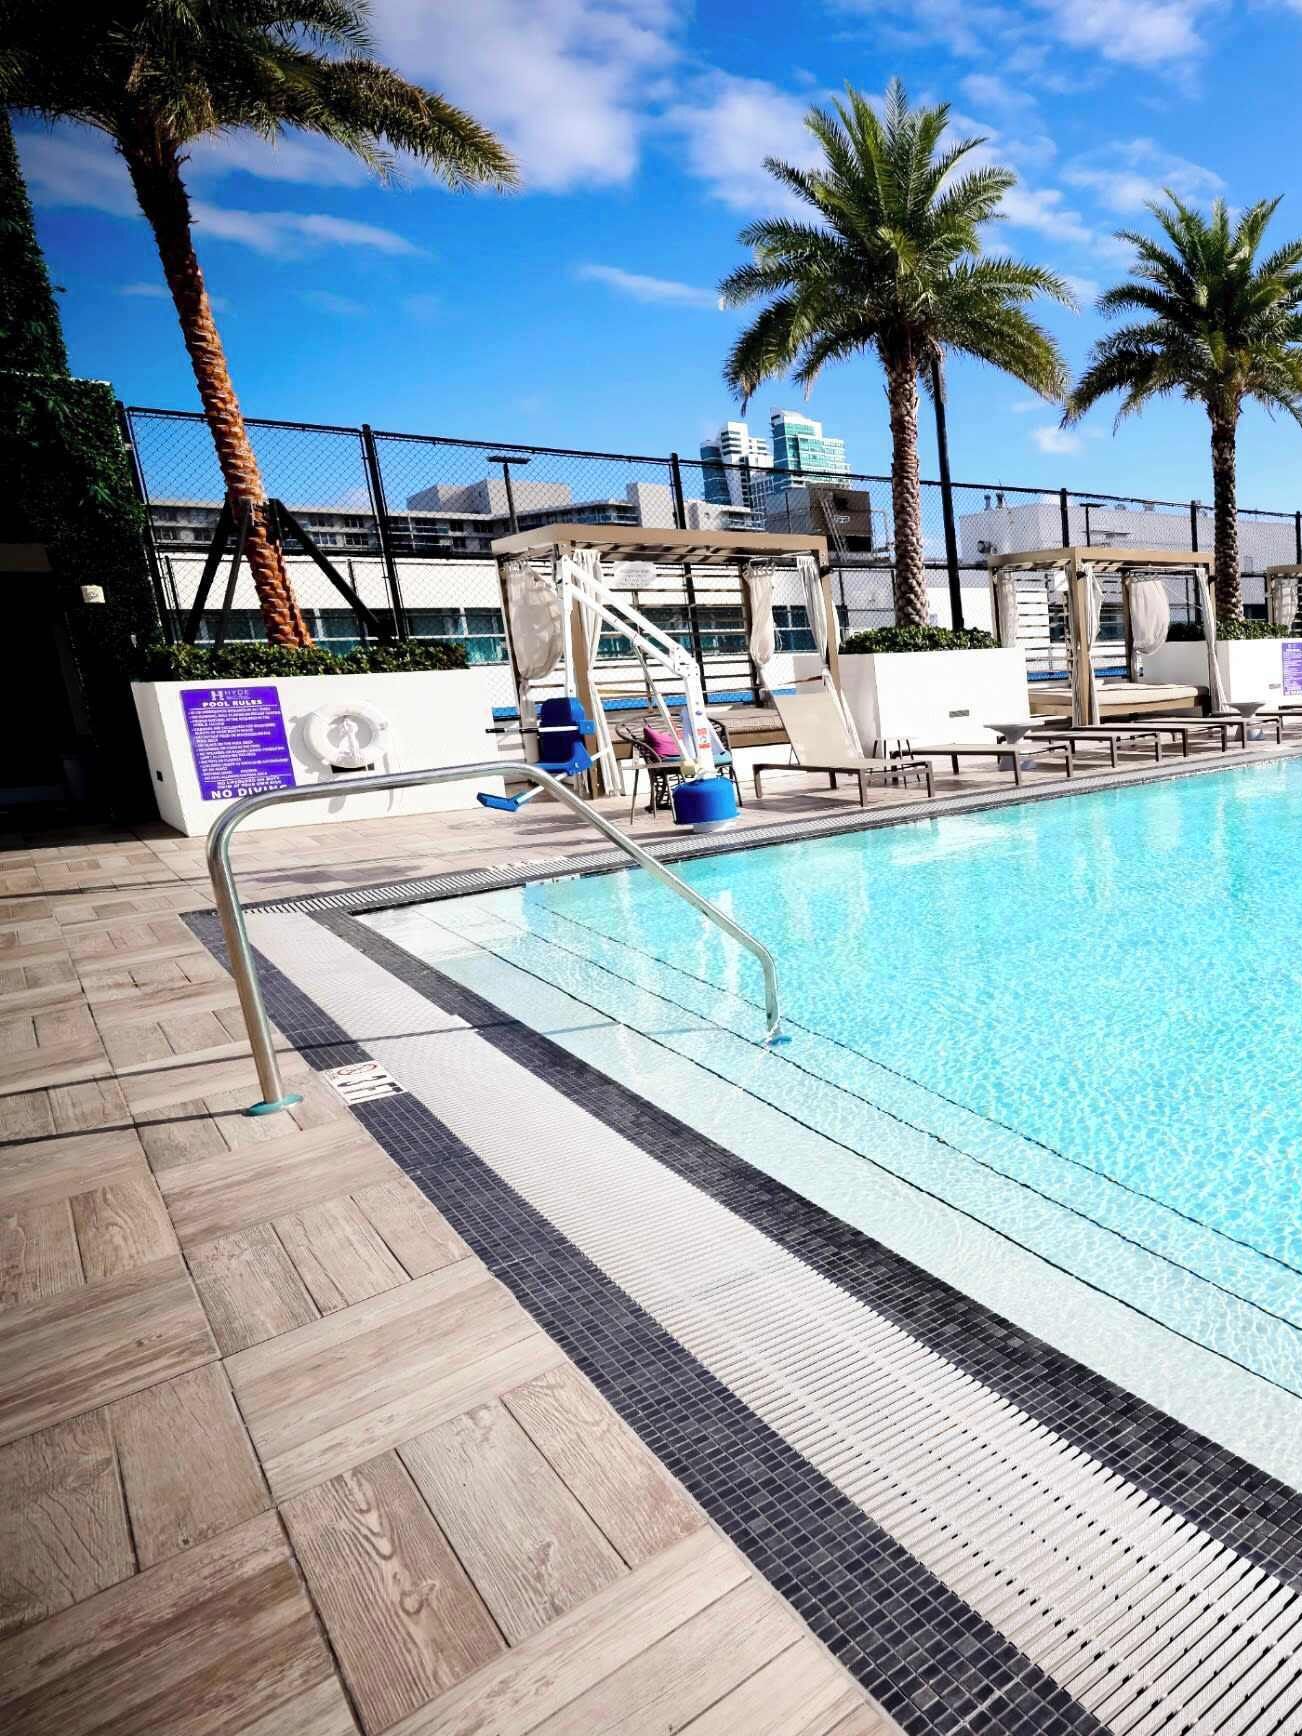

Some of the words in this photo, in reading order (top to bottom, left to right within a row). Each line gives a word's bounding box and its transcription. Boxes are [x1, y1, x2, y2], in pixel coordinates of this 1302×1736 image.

[211, 789, 232, 799] NO
[337, 1074, 387, 1088] 3
[344, 1081, 404, 1101] FT
